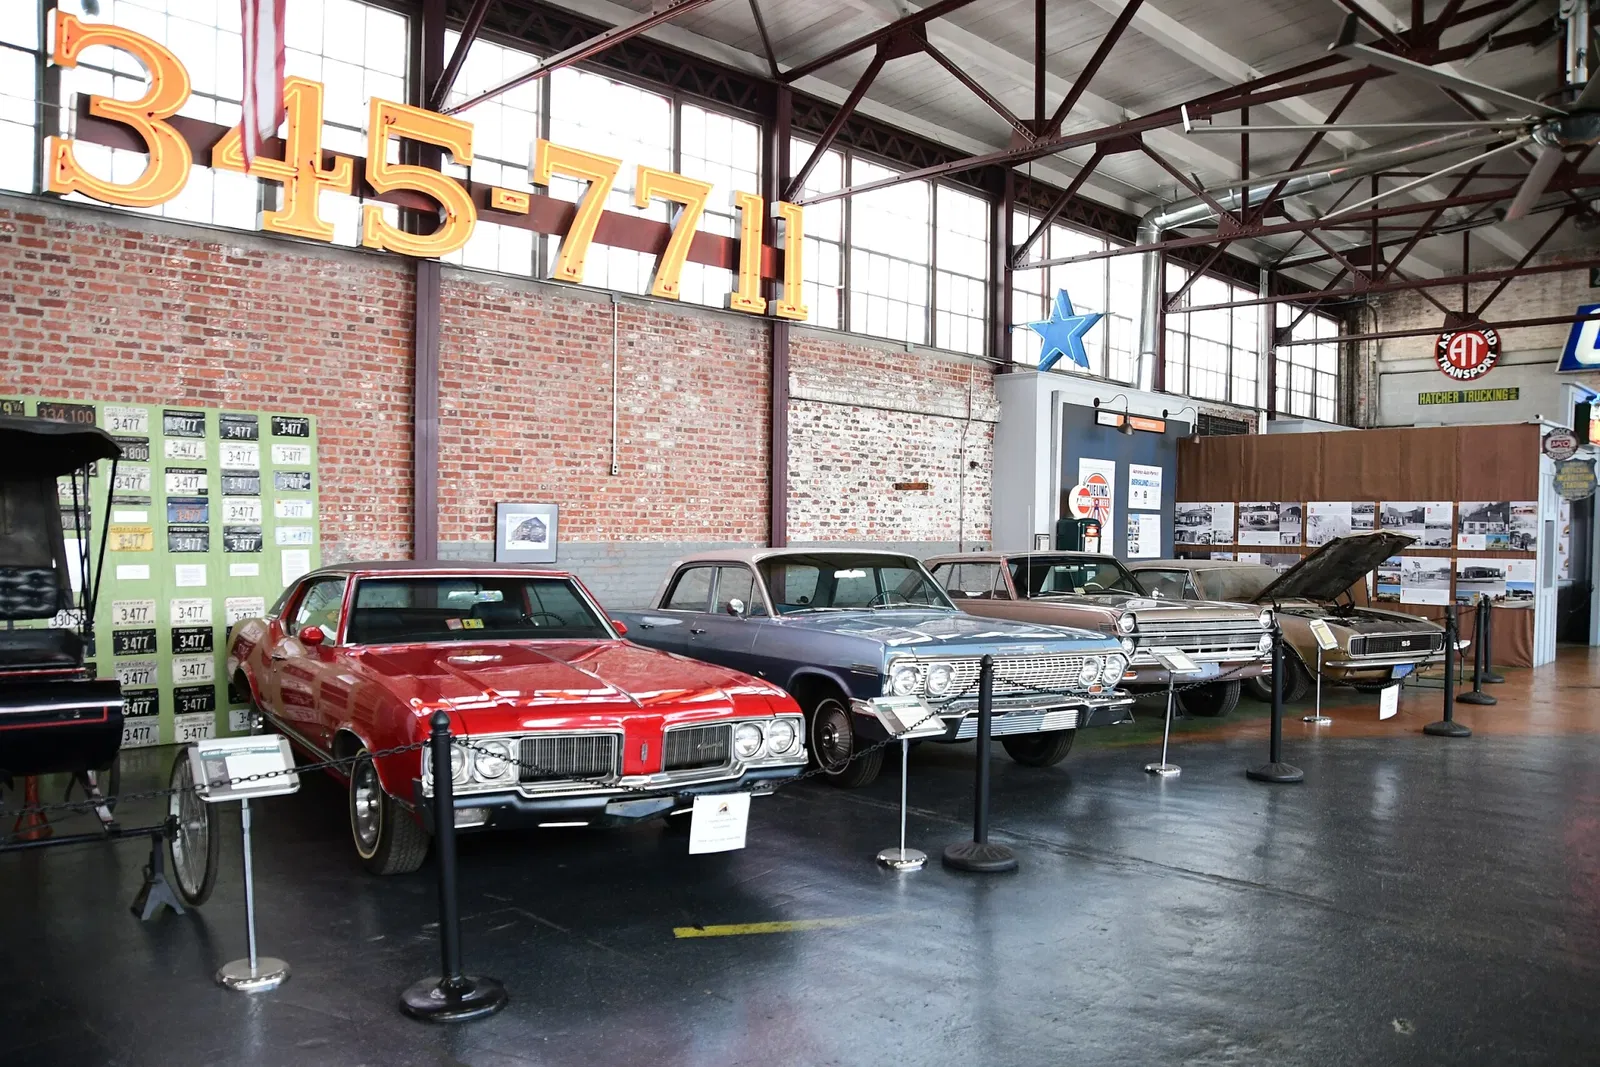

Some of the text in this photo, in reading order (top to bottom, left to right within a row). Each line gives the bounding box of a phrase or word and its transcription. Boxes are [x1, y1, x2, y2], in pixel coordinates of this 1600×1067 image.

[46, 8, 808, 321] 345-7711
[1438, 351, 1497, 379] TRANSPORT
[1450, 333, 1484, 367] AT
[1420, 391, 1459, 405] HATCHER
[1463, 388, 1509, 403] TRUCKING
